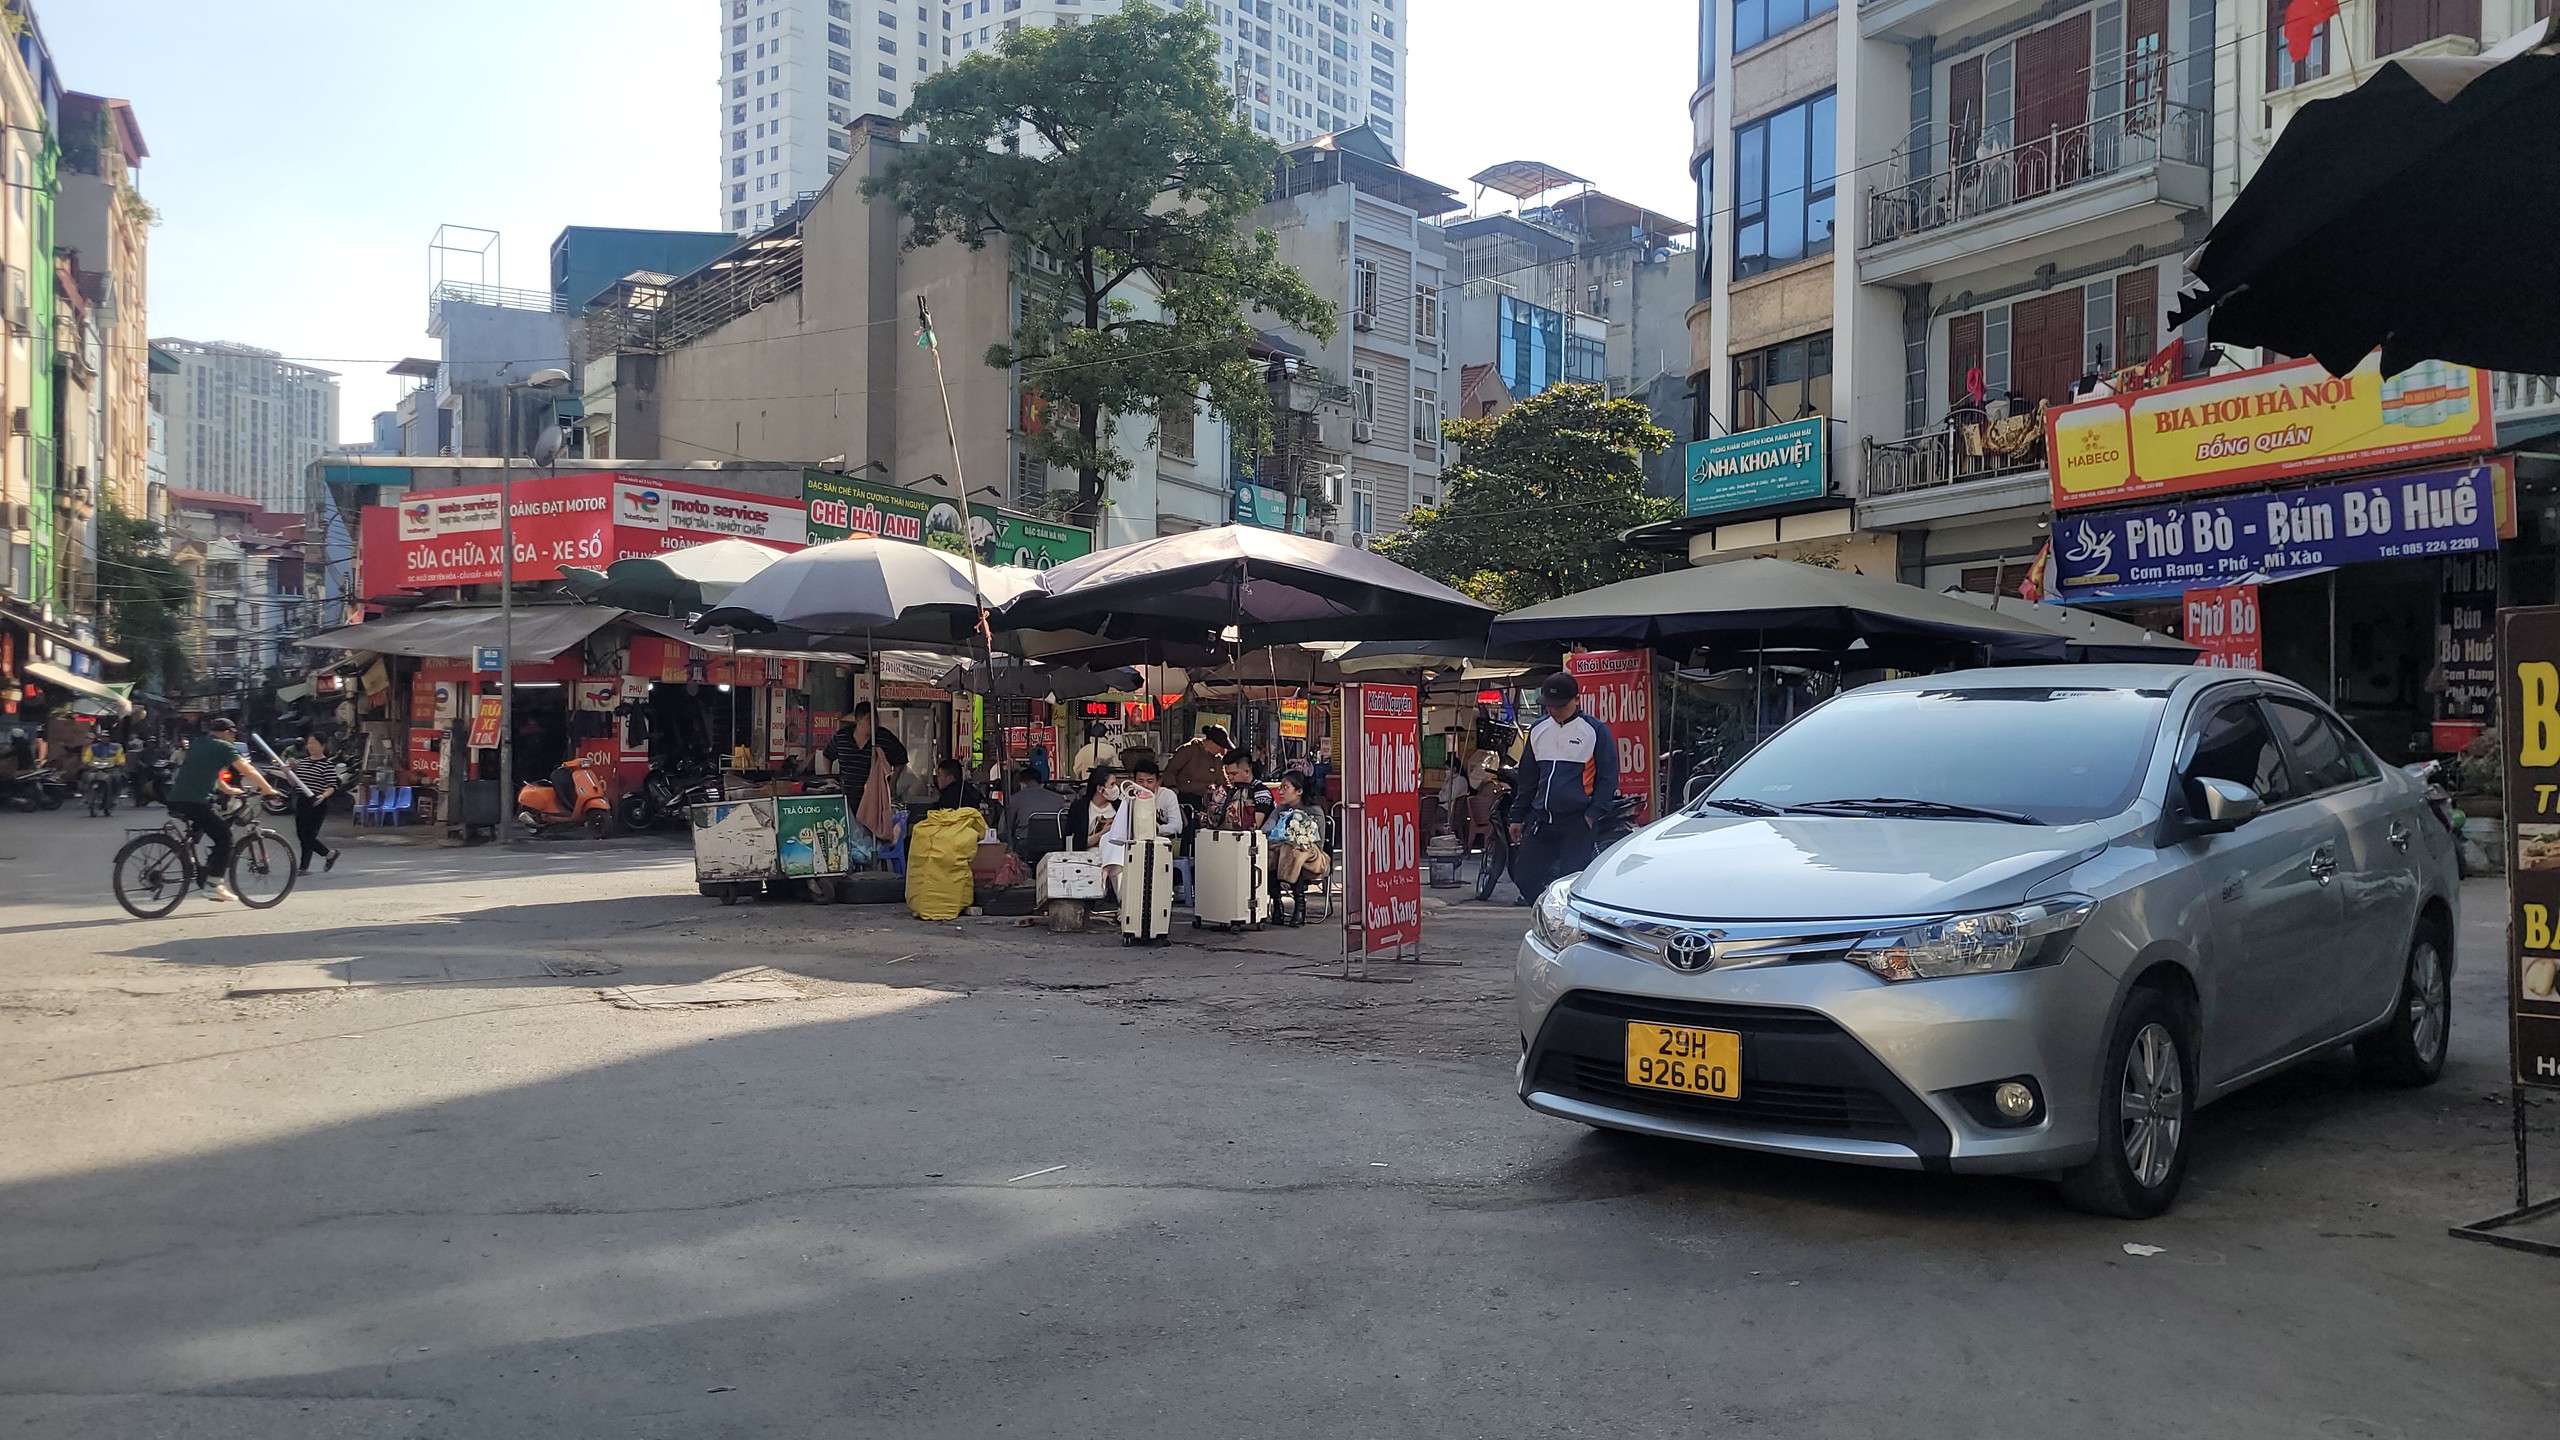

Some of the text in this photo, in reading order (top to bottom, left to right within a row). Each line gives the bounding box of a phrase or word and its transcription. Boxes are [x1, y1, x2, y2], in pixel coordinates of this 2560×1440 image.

[2154, 375, 2355, 434] BIA HƠI HÀ NỘI
[1761, 436, 1774, 444] KHOA
[2254, 424, 2313, 453] QUÁN
[1708, 439, 1812, 479] NHA KHOA VIỆT
[2068, 450, 2119, 468] HABECO
[542, 502, 564, 517] ĐẠT
[567, 496, 607, 513] MOTOR
[624, 512, 659, 523] TotalEnergies
[672, 499, 769, 523] moto services
[2127, 509, 2185, 560] Phở
[2192, 508, 2233, 553] Bò
[2266, 497, 2334, 546] Bún
[2344, 487, 2392, 537] Bò
[2402, 468, 2481, 531] Huế
[811, 499, 921, 542] CHÈ HẢI ANH
[408, 544, 438, 570] SỬA
[441, 541, 486, 568] CHỮA
[553, 540, 575, 561] XE
[578, 529, 603, 559] SỐ
[2380, 546, 2400, 558] Tel:
[2130, 564, 2162, 581] Cơm
[2166, 560, 2204, 578] Rang
[2218, 554, 2249, 573] Phở
[2264, 552, 2285, 568] Mì
[2290, 550, 2323, 567] Xào
[2188, 596, 2256, 638] Phở Bò
[2454, 606, 2482, 630] Bún
[2441, 634, 2495, 663] Bò Huế
[1576, 658, 1640, 672] Khôi Nguyên
[2468, 669, 2495, 682] Rang
[628, 684, 643, 696] PHỤ
[1578, 676, 1646, 723] ún Bò Huế
[776, 706, 782, 714] XE
[1386, 692, 1413, 716] Nguyên
[482, 718, 497, 730] XE
[814, 716, 830, 728] SINH
[475, 732, 494, 744] 10K
[412, 758, 429, 771] SỬA
[586, 750, 611, 766] SƠN
[1365, 731, 1379, 796] Bún
[1381, 731, 1394, 795] Bò
[1396, 723, 1417, 793] Huế
[1618, 736, 1645, 774] Bò
[782, 806, 797, 815] TRÀ
[804, 806, 821, 814] LONG
[1368, 808, 1415, 876] Phở Bò
[1368, 896, 1418, 930] Cơm Rang
[1659, 1028, 1706, 1060] 29H
[1639, 1057, 1726, 1093] 926.60
